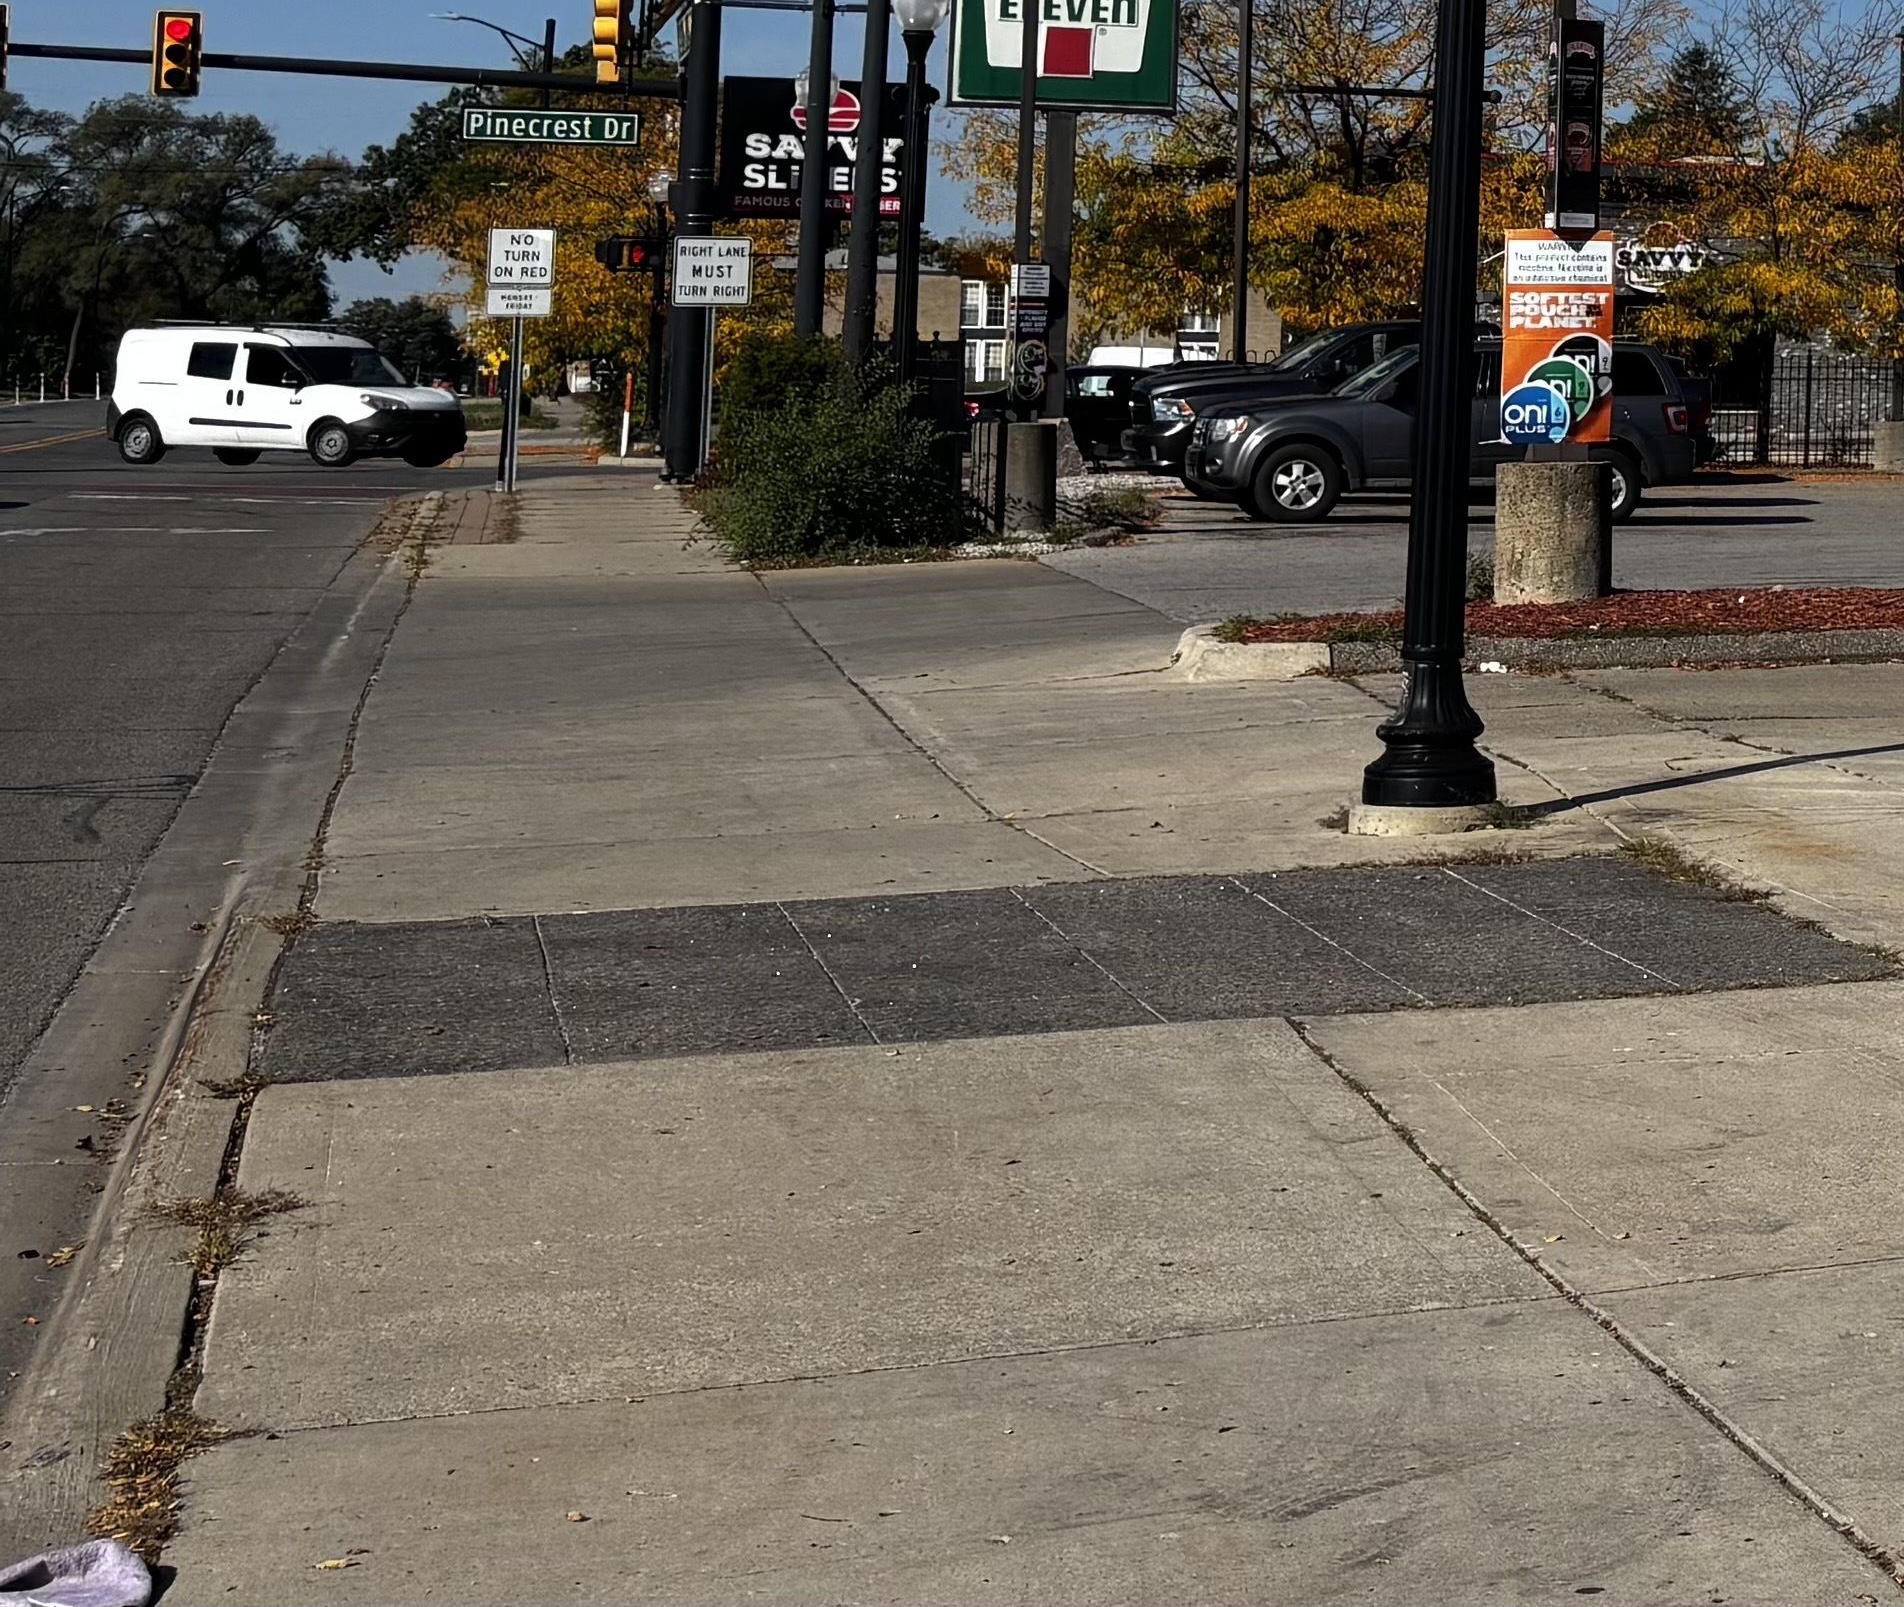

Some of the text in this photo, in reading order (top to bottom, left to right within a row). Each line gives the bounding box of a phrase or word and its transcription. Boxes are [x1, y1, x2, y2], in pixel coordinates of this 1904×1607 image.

[469, 111, 632, 140] Pinecrest Dr
[734, 195, 791, 208] FAMOUS
[510, 234, 534, 246] NO
[504, 250, 541, 262] TURN
[680, 245, 748, 258] RIGHT LANE
[1617, 249, 1704, 268] SAVVY
[494, 266, 548, 278] ON RED
[692, 264, 733, 279] MUST
[678, 285, 746, 297] TURN RIGHT
[1509, 291, 1610, 305] SOFTEST
[1504, 404, 1548, 424] on!
[1505, 425, 1547, 434] PLUS
